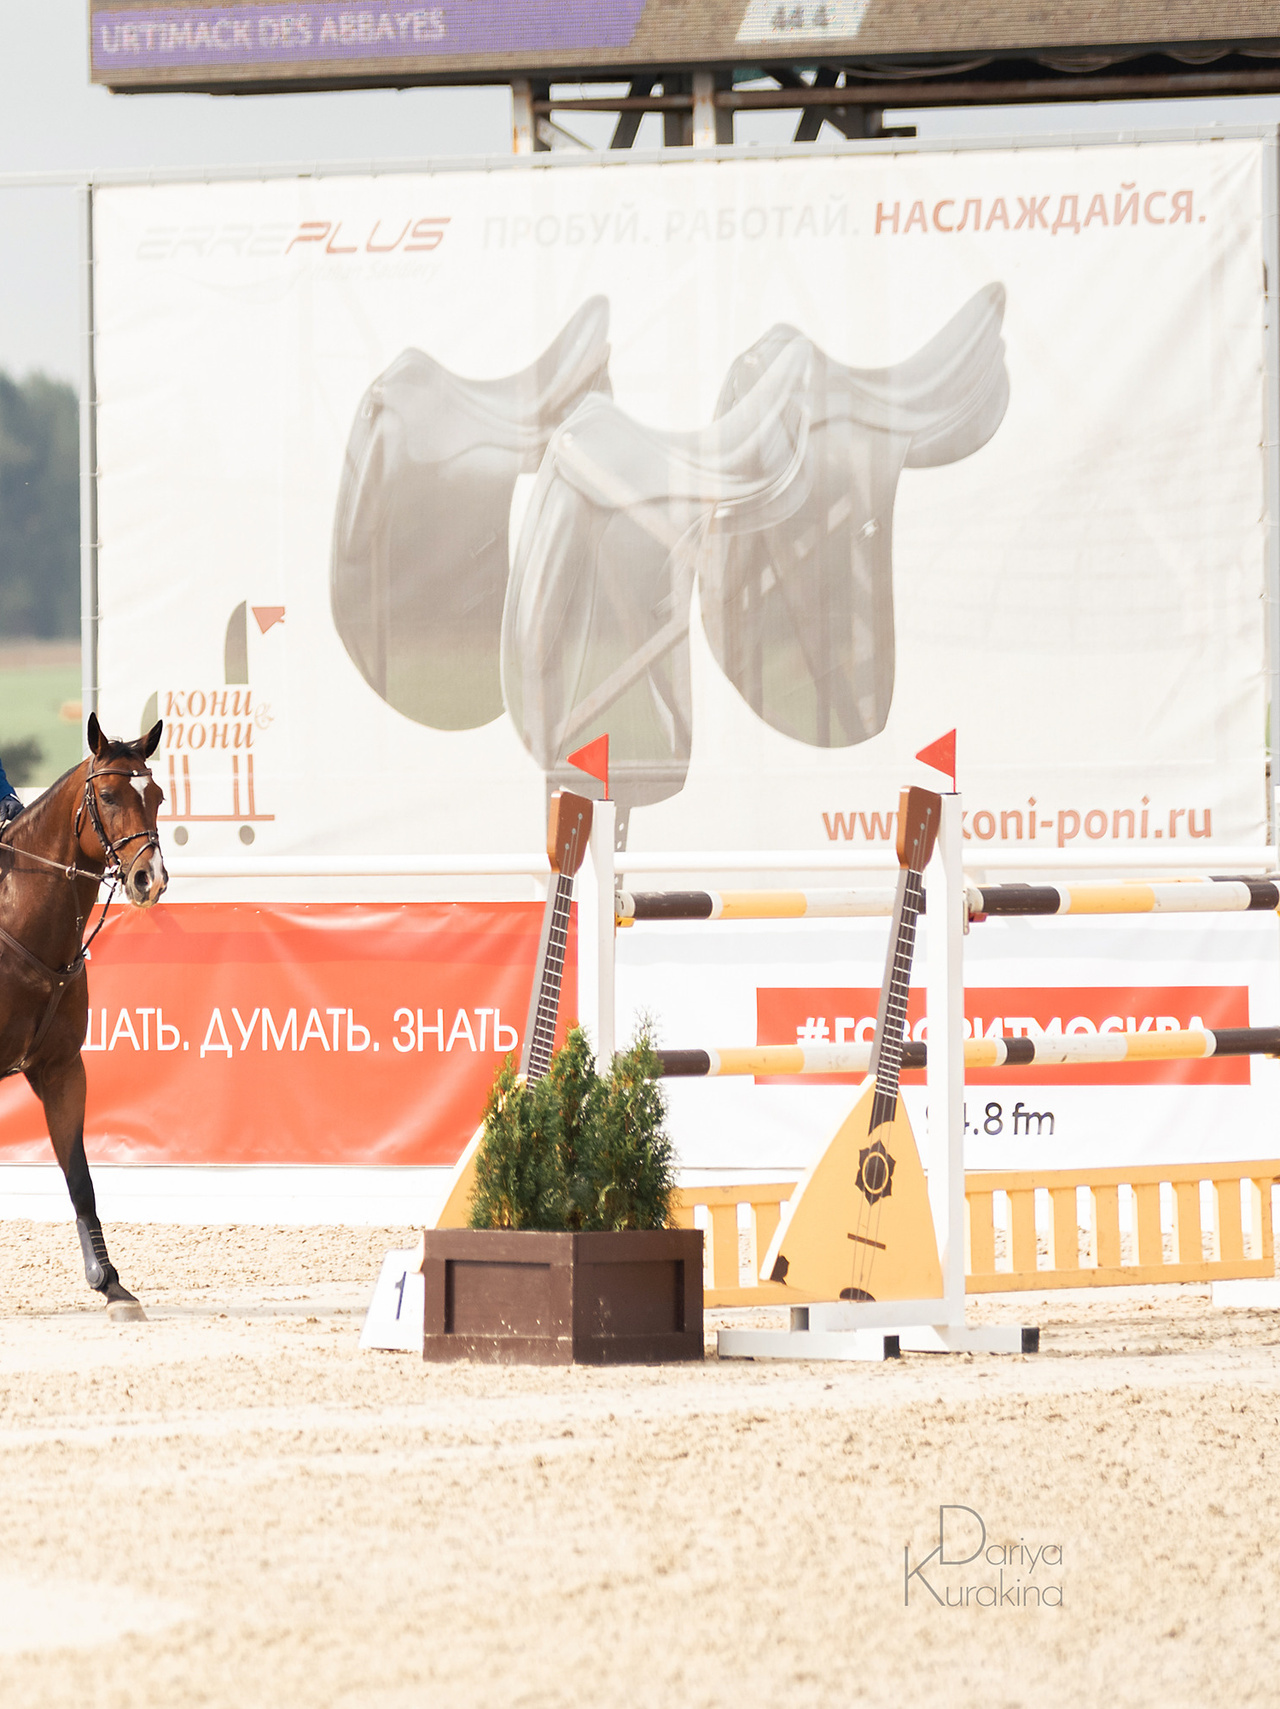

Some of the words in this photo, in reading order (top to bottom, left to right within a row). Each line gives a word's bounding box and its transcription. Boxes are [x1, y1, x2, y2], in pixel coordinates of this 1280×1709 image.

[258, 13, 314, 48] DES
[319, 8, 448, 46] ABBAYES
[482, 202, 651, 249] ПРОБУЙ.
[665, 193, 860, 243] РАБОТАЙ.
[874, 183, 1207, 236] НАСЛАЖДАЙСЯ.
[199, 1007, 380, 1059] ДУМАТЬ.
[391, 1007, 525, 1053] ЗНАТЬ
[1012, 1102, 1056, 1136] fm
[394, 1271, 407, 1320] 1
